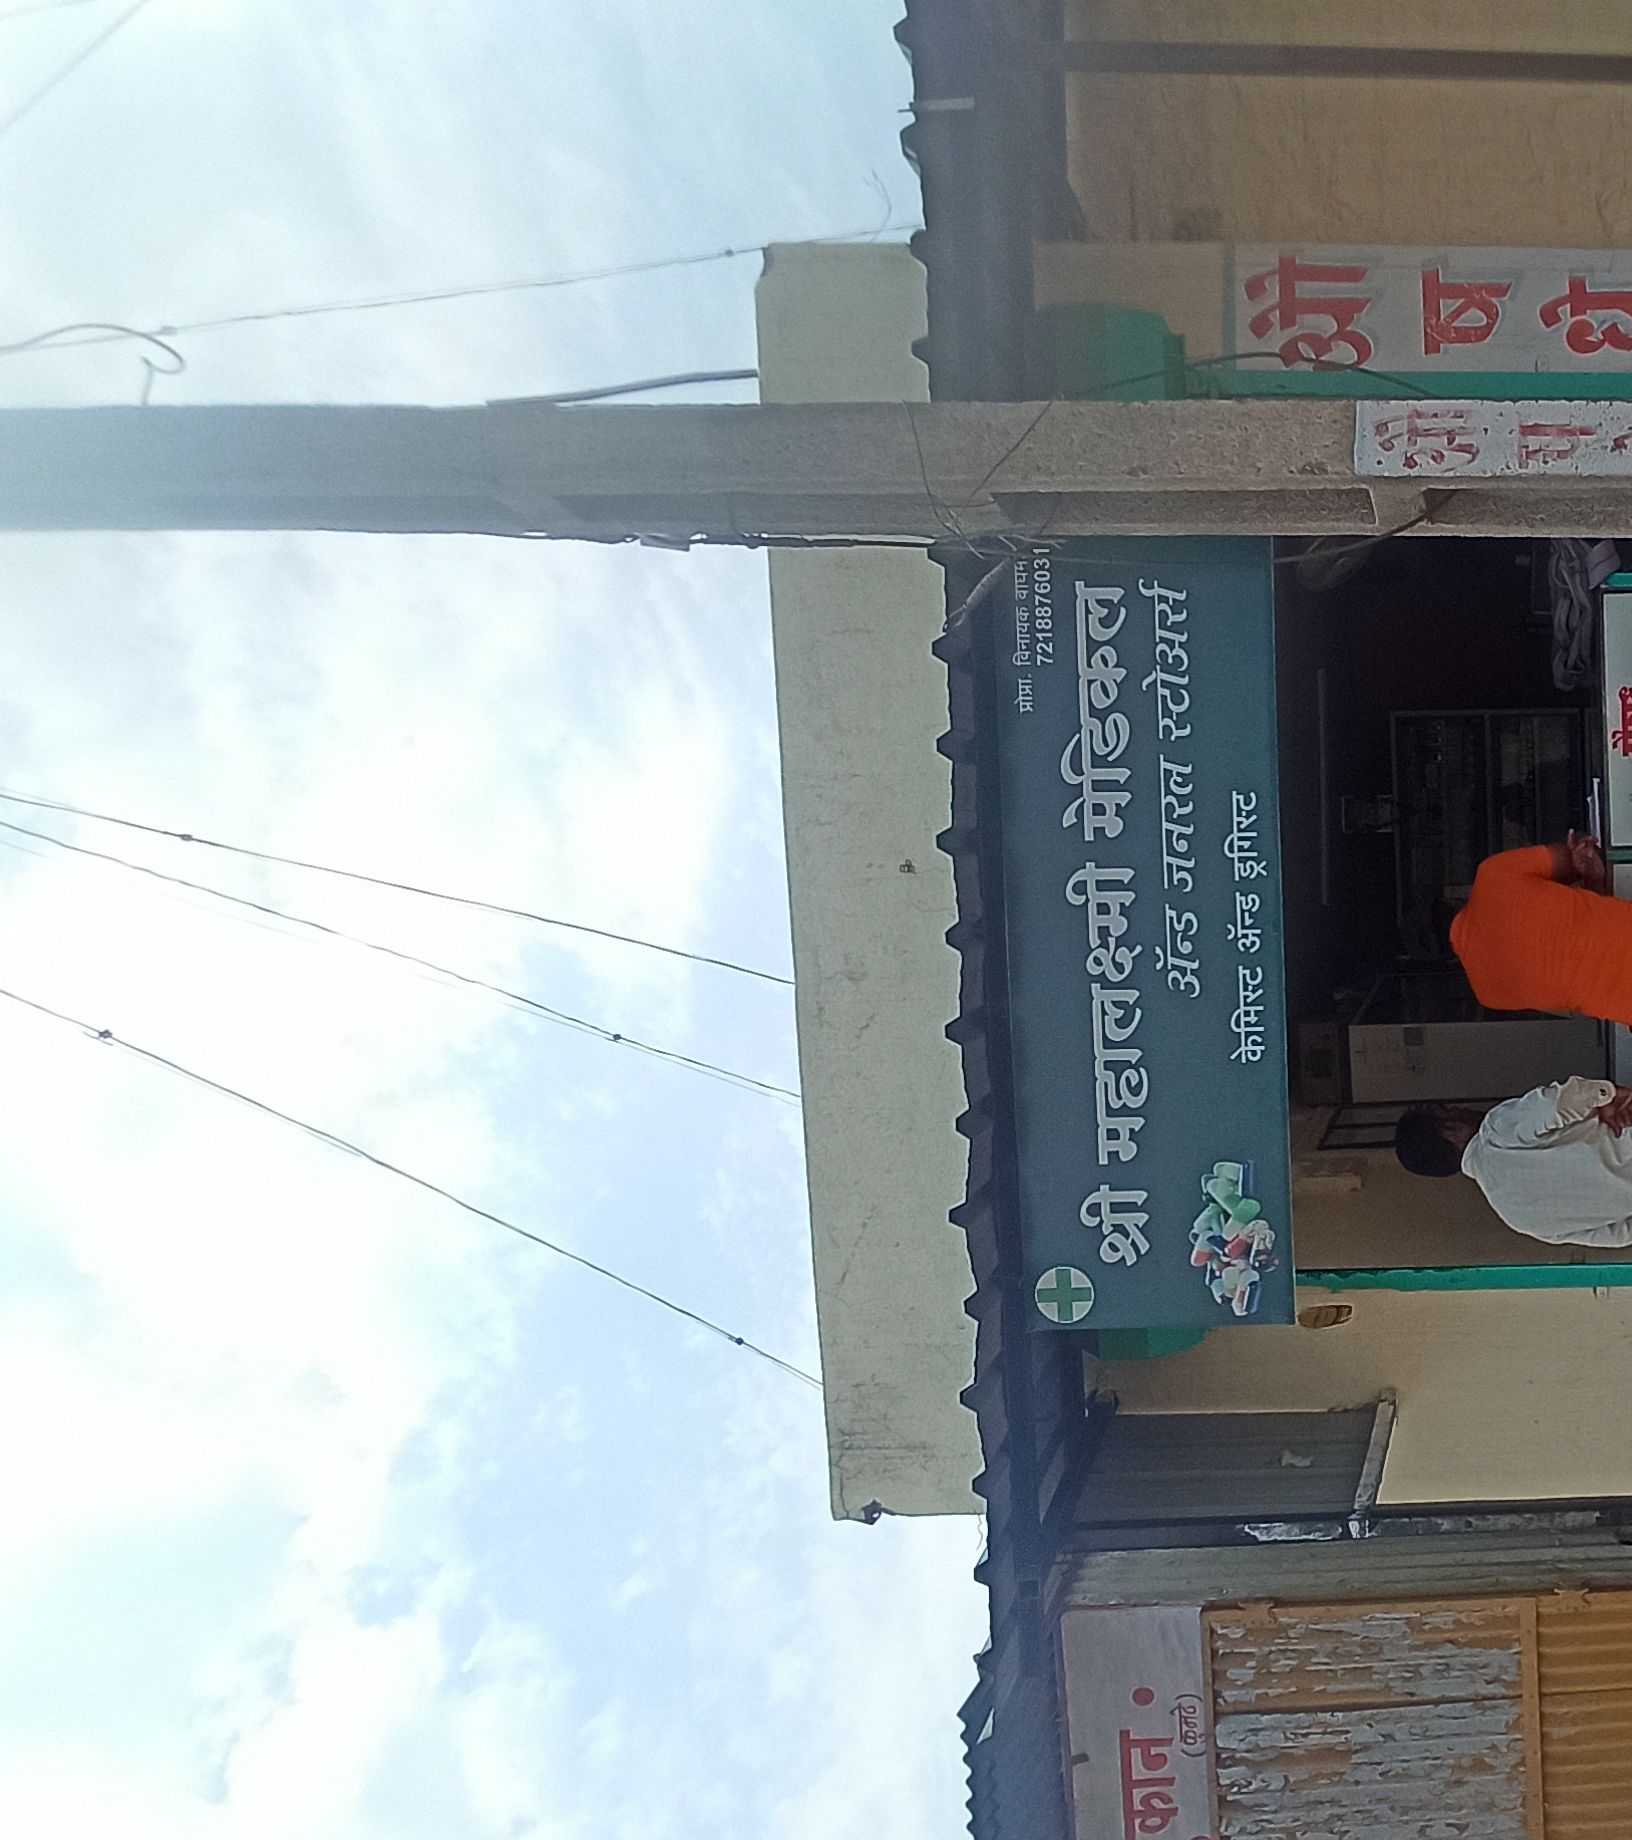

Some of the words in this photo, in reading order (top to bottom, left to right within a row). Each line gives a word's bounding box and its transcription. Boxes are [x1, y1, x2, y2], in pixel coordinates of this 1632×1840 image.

[1012, 606, 1031, 666] विनायक
[1033, 548, 1053, 666] 7218876031
[1139, 578, 1192, 741] स्टोअर्स
[1061, 581, 1132, 840] मेडिकल
[1159, 754, 1196, 893] जनरल
[1224, 791, 1267, 880] ड्रगिस्ट
[1066, 861, 1148, 1165] महालक्ष्मी
[1230, 965, 1266, 1063] केमिस्ट
[1080, 1184, 1150, 1267] श्री
[1119, 1729, 1179, 1840] कान
